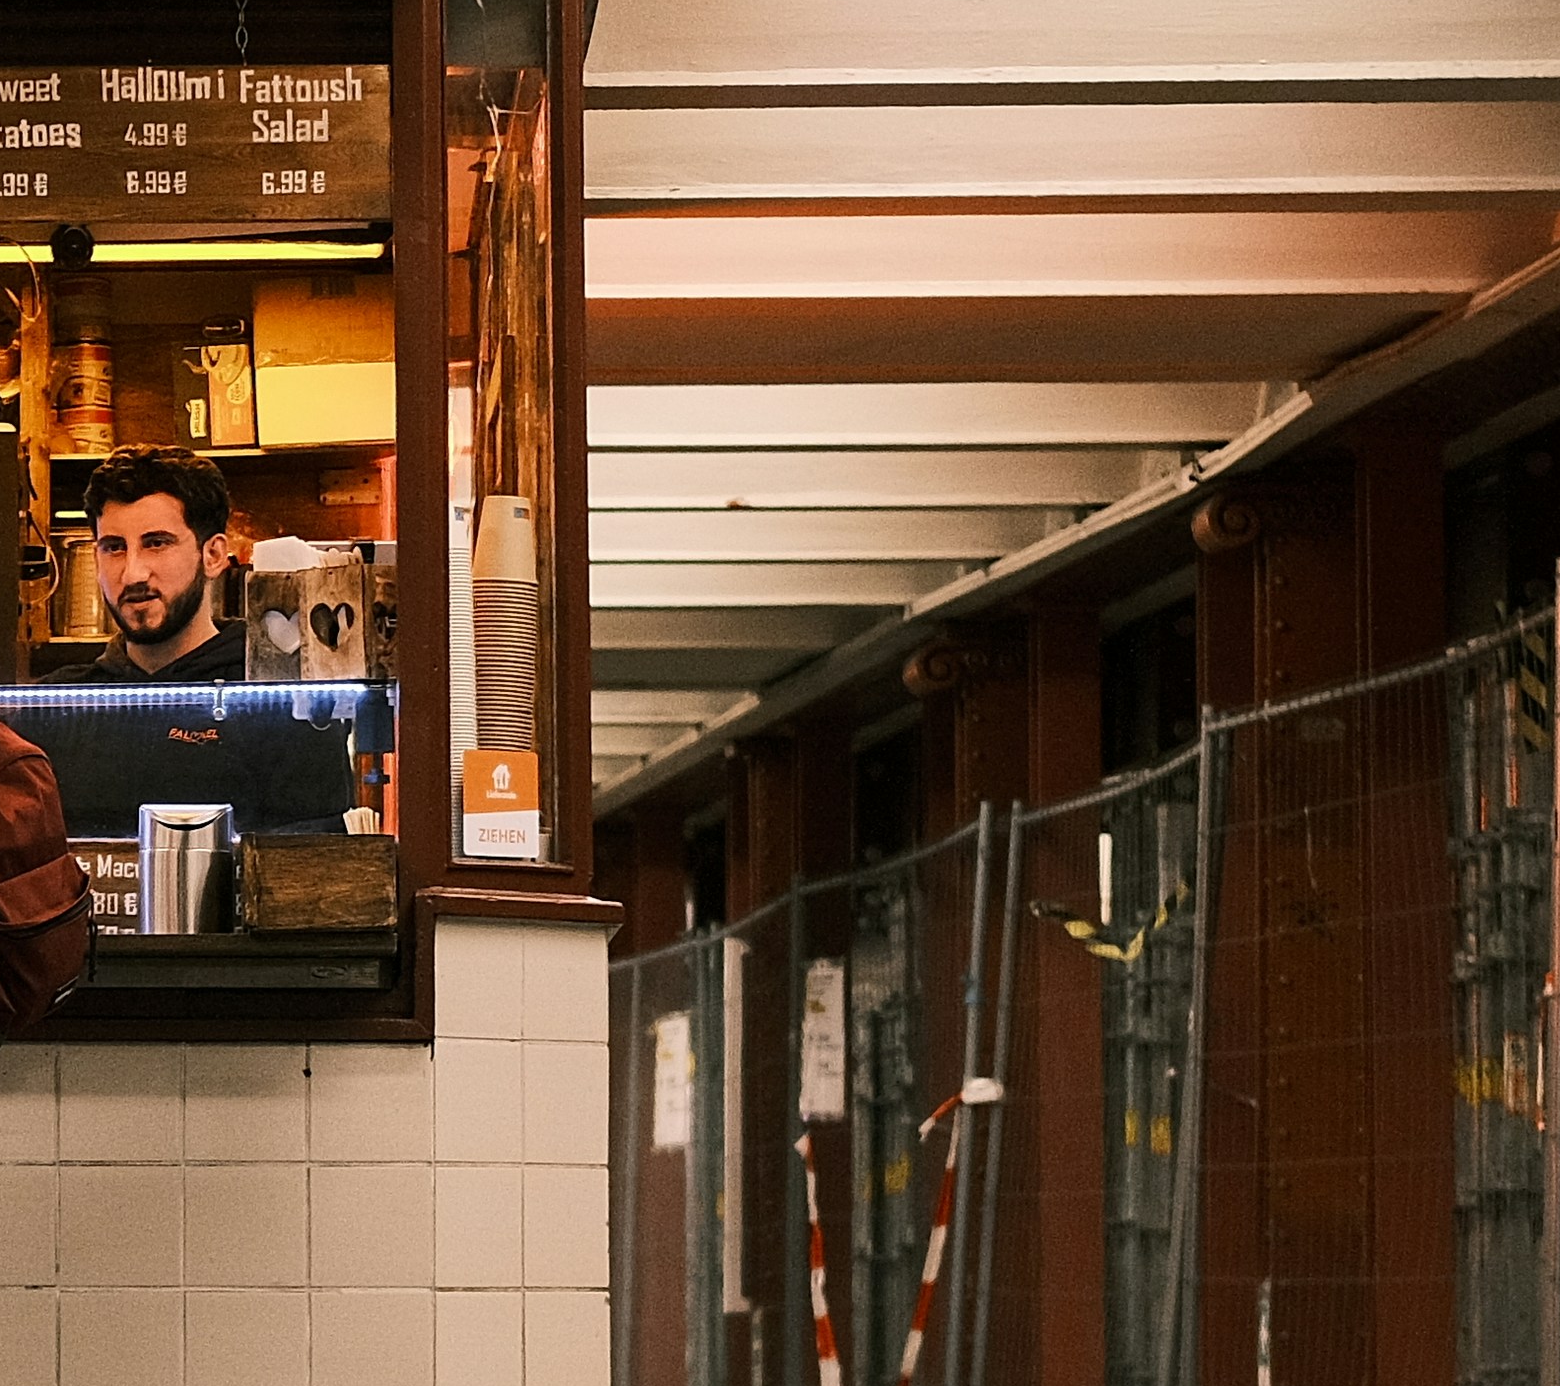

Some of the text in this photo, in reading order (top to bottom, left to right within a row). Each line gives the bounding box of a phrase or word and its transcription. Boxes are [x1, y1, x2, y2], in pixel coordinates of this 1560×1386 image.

[239, 66, 362, 104] Fattoush
[252, 108, 329, 143] Salad
[477, 827, 527, 845] ZIEHEN
